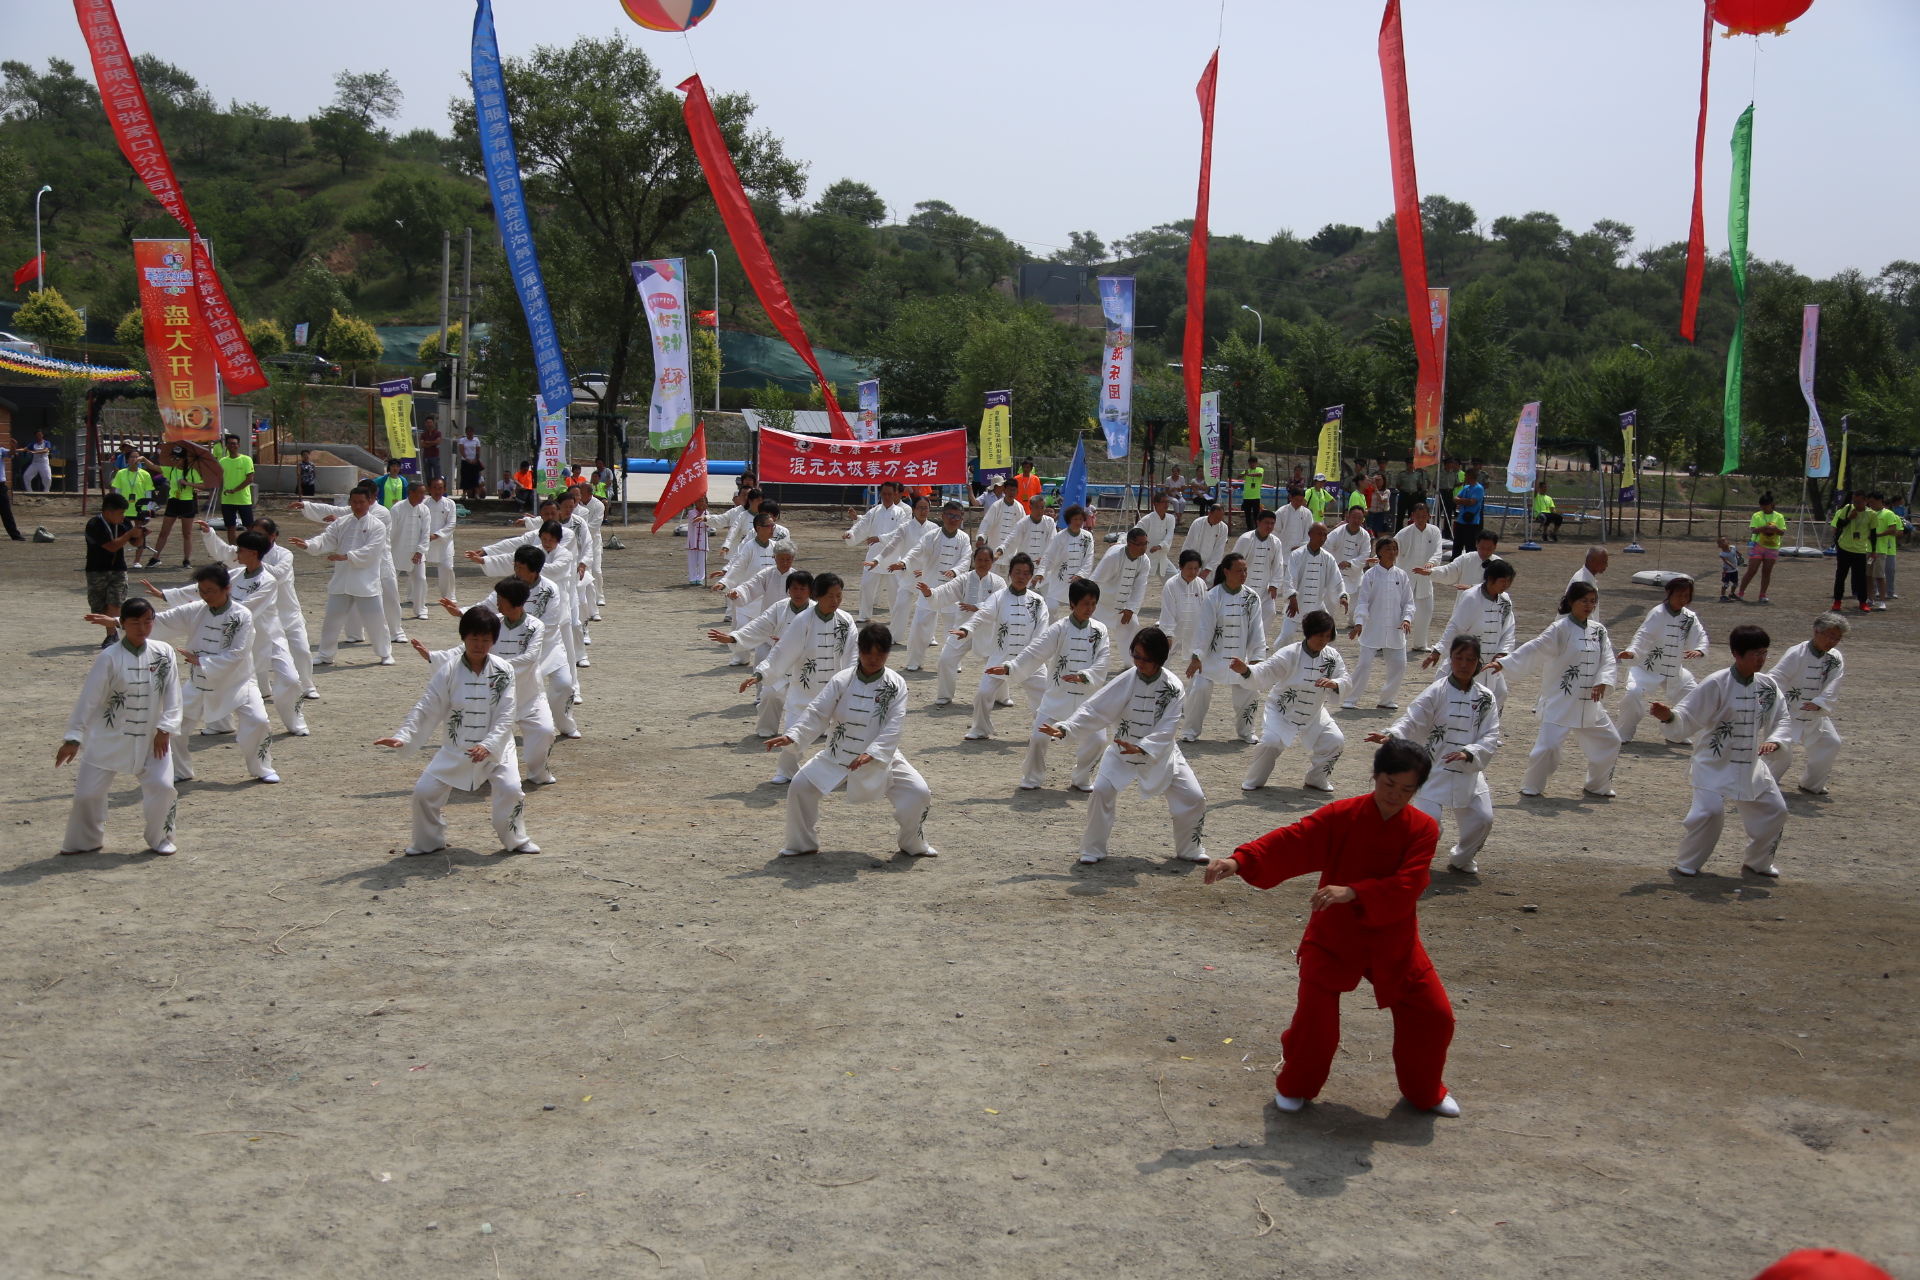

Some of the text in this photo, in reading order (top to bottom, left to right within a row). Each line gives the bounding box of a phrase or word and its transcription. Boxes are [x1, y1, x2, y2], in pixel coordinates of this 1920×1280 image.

[828, 443, 903, 455] 健康工程
[789, 457, 939, 479] 混元太极拳万全站
